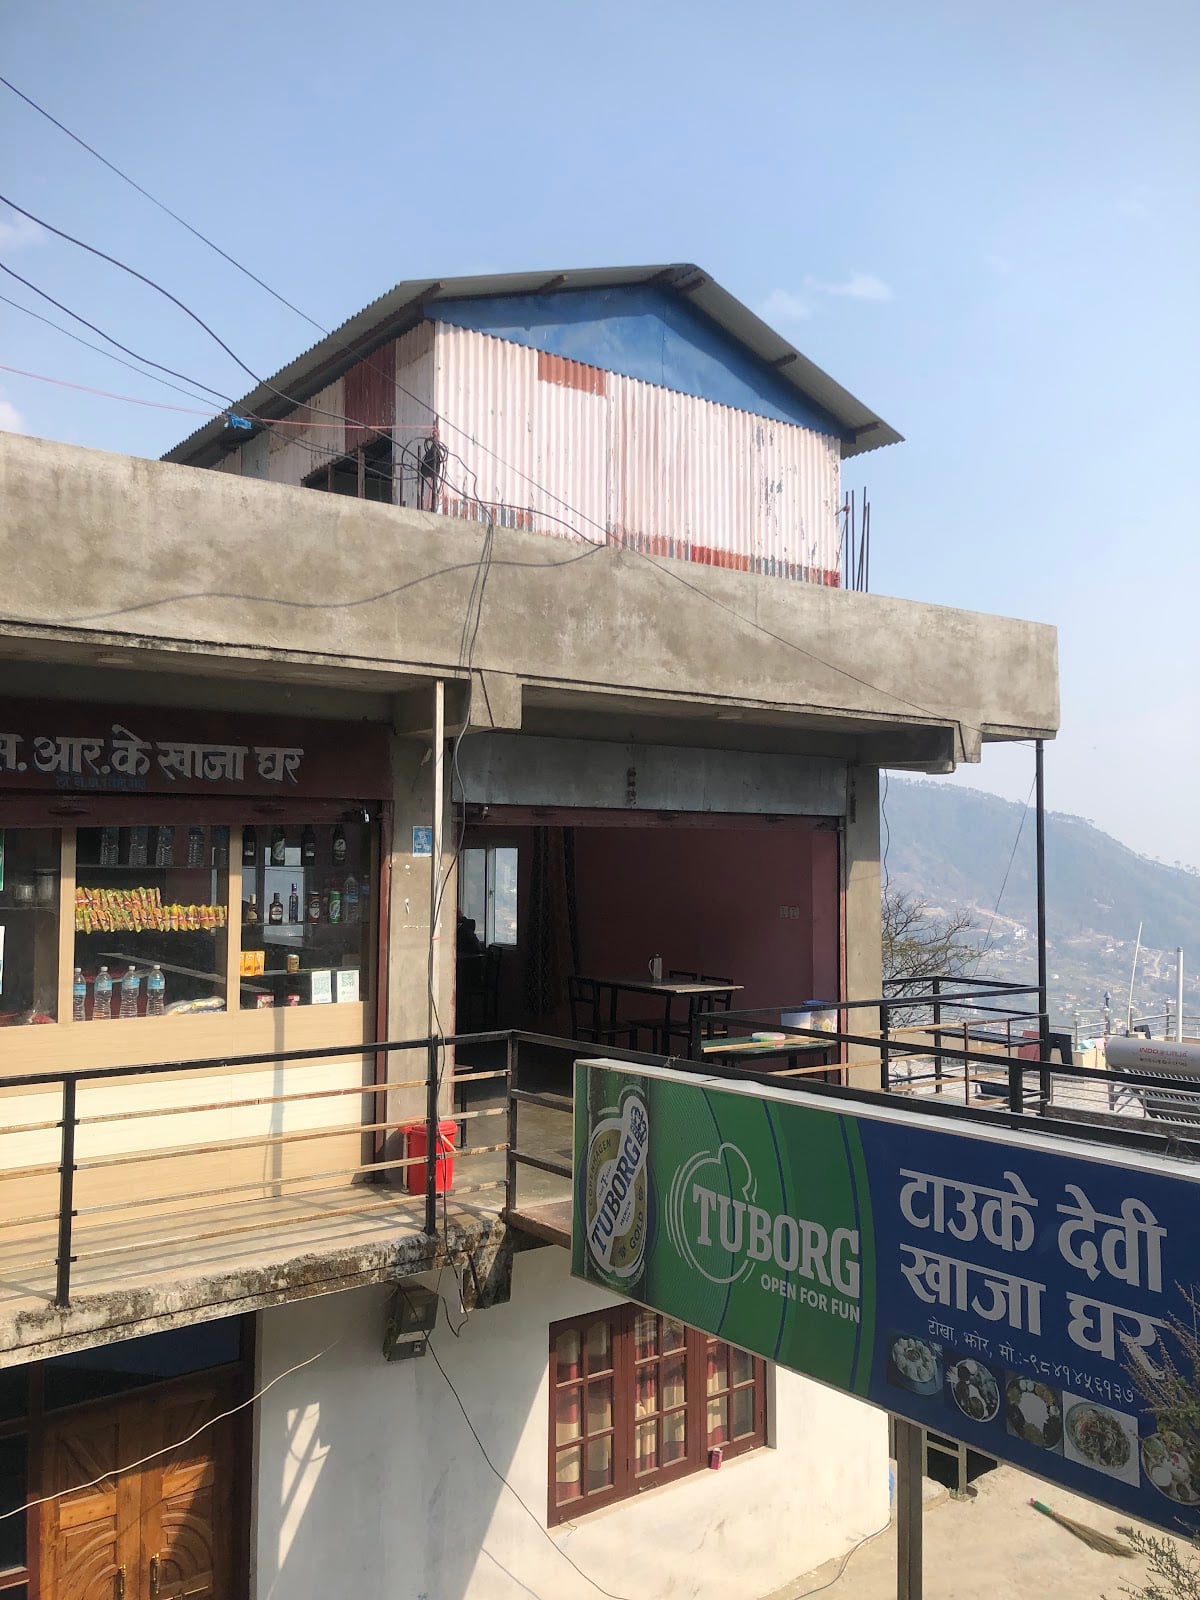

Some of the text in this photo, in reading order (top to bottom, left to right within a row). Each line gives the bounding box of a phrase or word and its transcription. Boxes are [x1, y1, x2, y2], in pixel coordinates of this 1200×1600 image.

[155, 742, 249, 780] खाजा
[254, 746, 304, 783] घर
[591, 1134, 641, 1257] TUBORG
[629, 1211, 644, 1250] GOLD
[693, 1183, 861, 1299] TUBORG
[899, 1168, 1168, 1294] टाउके देवी
[760, 1273, 861, 1324] OPEN FOR FUN
[899, 1243, 1171, 1380] खाजा घर
